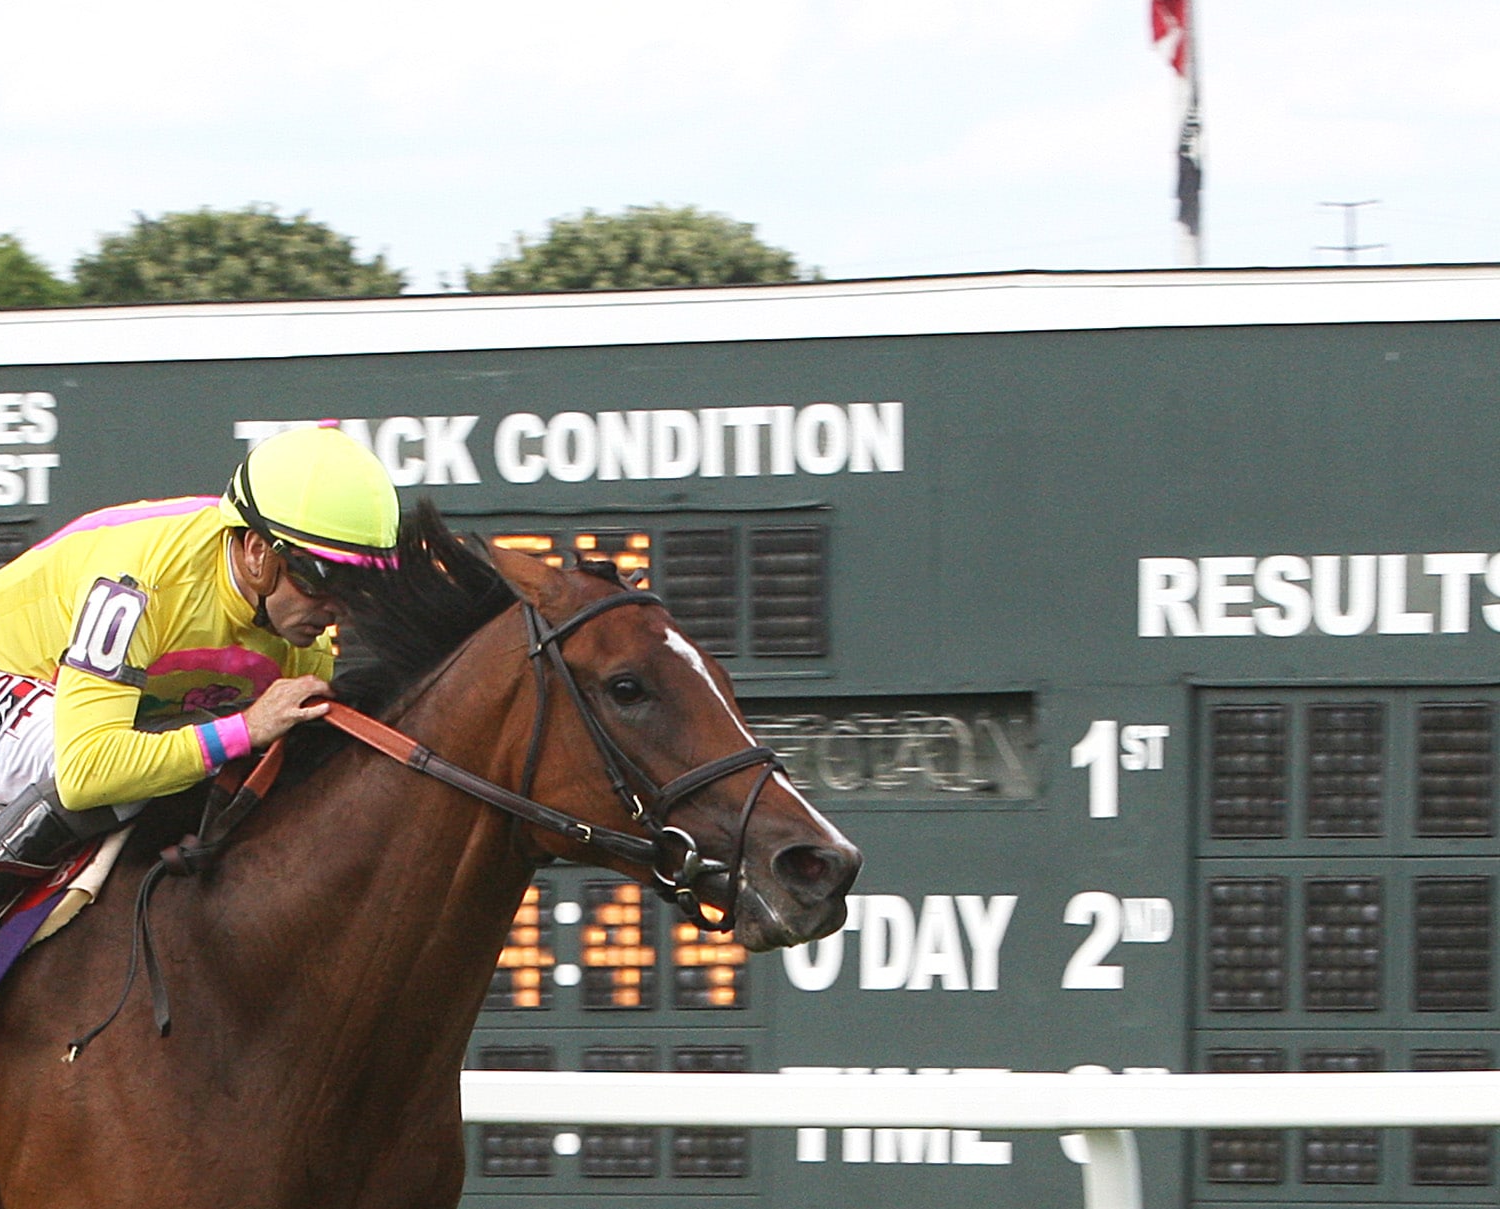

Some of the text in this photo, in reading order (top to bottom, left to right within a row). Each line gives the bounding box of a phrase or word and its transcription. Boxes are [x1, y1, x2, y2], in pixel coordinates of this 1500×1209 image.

[494, 402, 905, 484] CONDITION
[66, 584, 142, 671] 10
[1138, 552, 1500, 638] RESULT
[1070, 719, 1170, 819] 1ST
